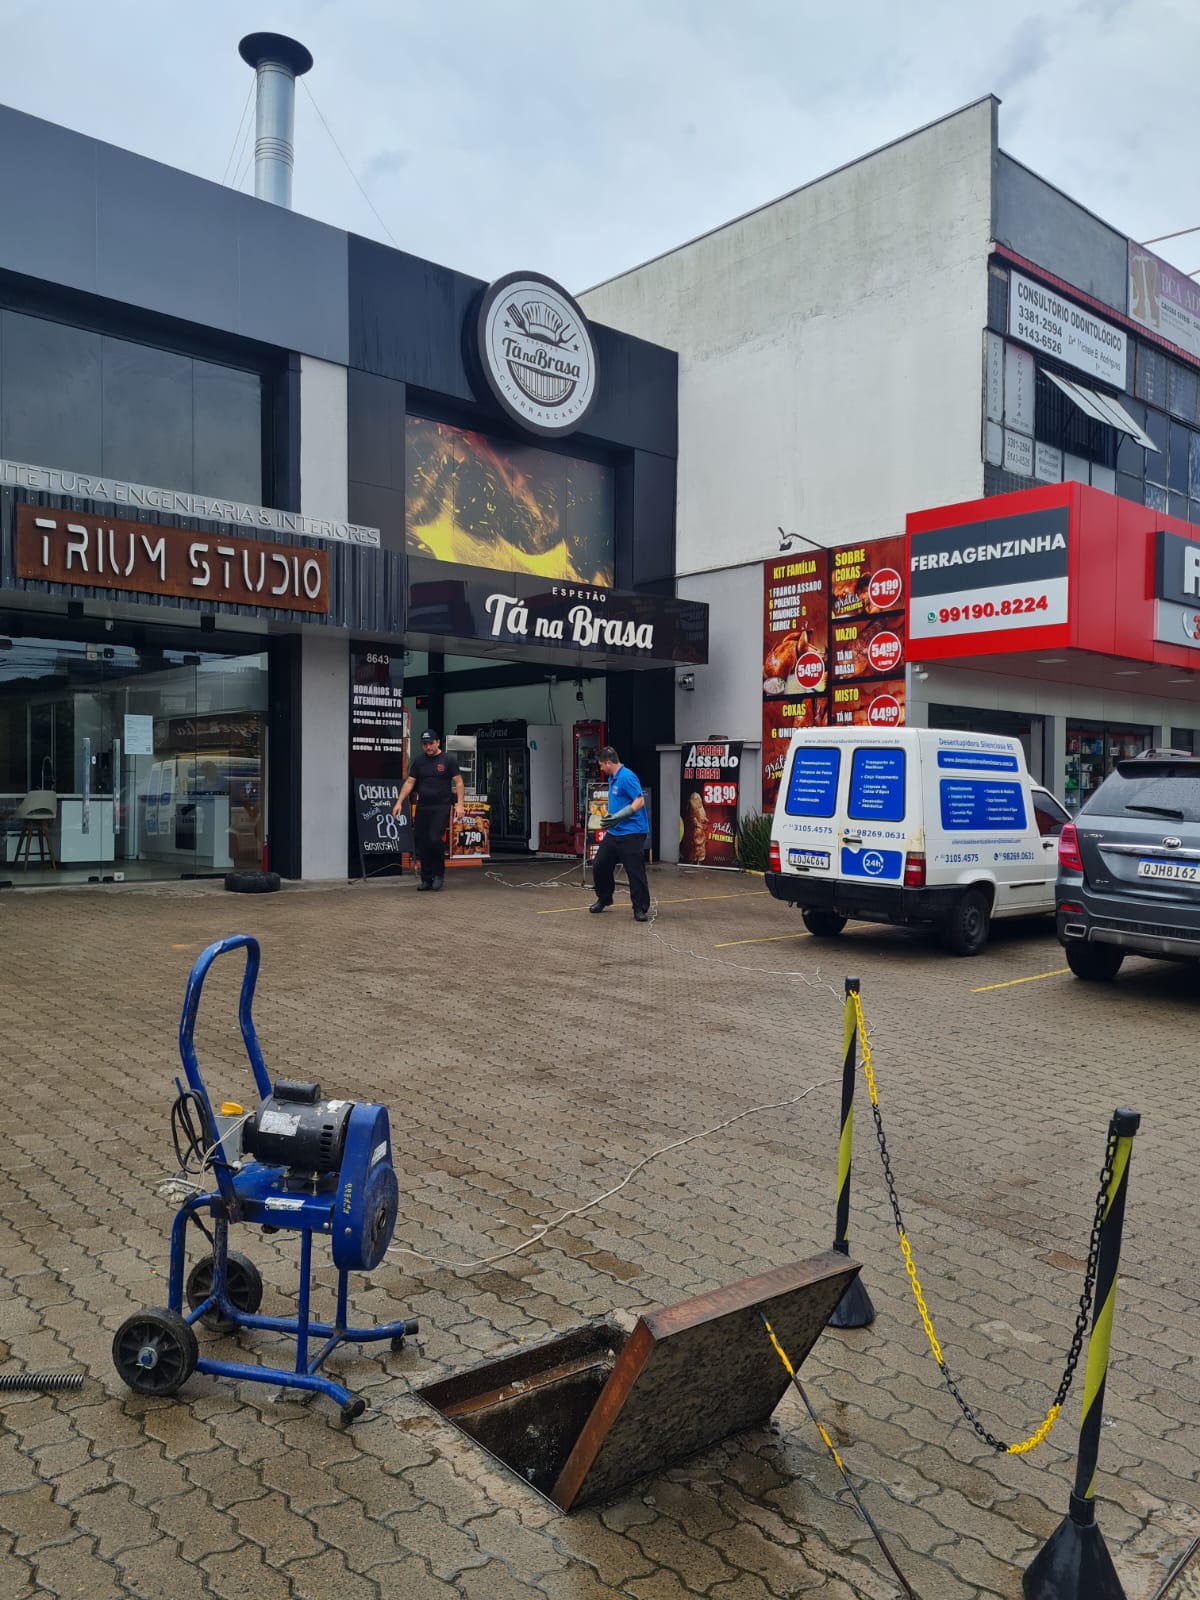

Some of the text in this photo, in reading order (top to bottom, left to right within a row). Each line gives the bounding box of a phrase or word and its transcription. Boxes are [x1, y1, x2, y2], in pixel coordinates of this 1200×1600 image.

[1018, 282, 1068, 322] CONSULTÓRIO
[1070, 311, 1122, 352] ODONTOLÓGICO
[1018, 305, 1062, 338] 3381-2594
[1018, 322, 1062, 354] 9143-6526
[500, 374, 584, 420] CHURRASCARIA
[114, 482, 253, 522] ENGENHARIA
[258, 508, 272, 526] &
[277, 512, 378, 544] INTERIORES
[34, 518, 322, 600] TRIUM STUDIO
[835, 549, 865, 566] SOBRE
[910, 533, 1066, 572] FERRAGENZINHA
[774, 560, 816, 580] KIT FAMÍLIA
[835, 566, 860, 582] COXAS
[552, 586, 606, 602] ESPETÃO
[797, 580, 822, 594] ASSADO
[939, 595, 1048, 623] 99190.8224
[485, 594, 654, 650] Tá na Brasa
[836, 627, 857, 641] VAZIO
[367, 653, 389, 664] 8643
[353, 684, 402, 697] HORÁRIOS DE
[834, 688, 859, 702] MISTO
[353, 696, 402, 708] ATENDIMENTO
[782, 704, 806, 717] COXAS
[772, 728, 777, 739] 6
[685, 744, 738, 768] Assado
[359, 784, 398, 800] COSTELA
[794, 824, 832, 834] 3105.4575
[857, 829, 906, 840] 98269.0631
[865, 859, 881, 868] 24h
[945, 852, 1035, 863] 3105.4575 98269.0631
